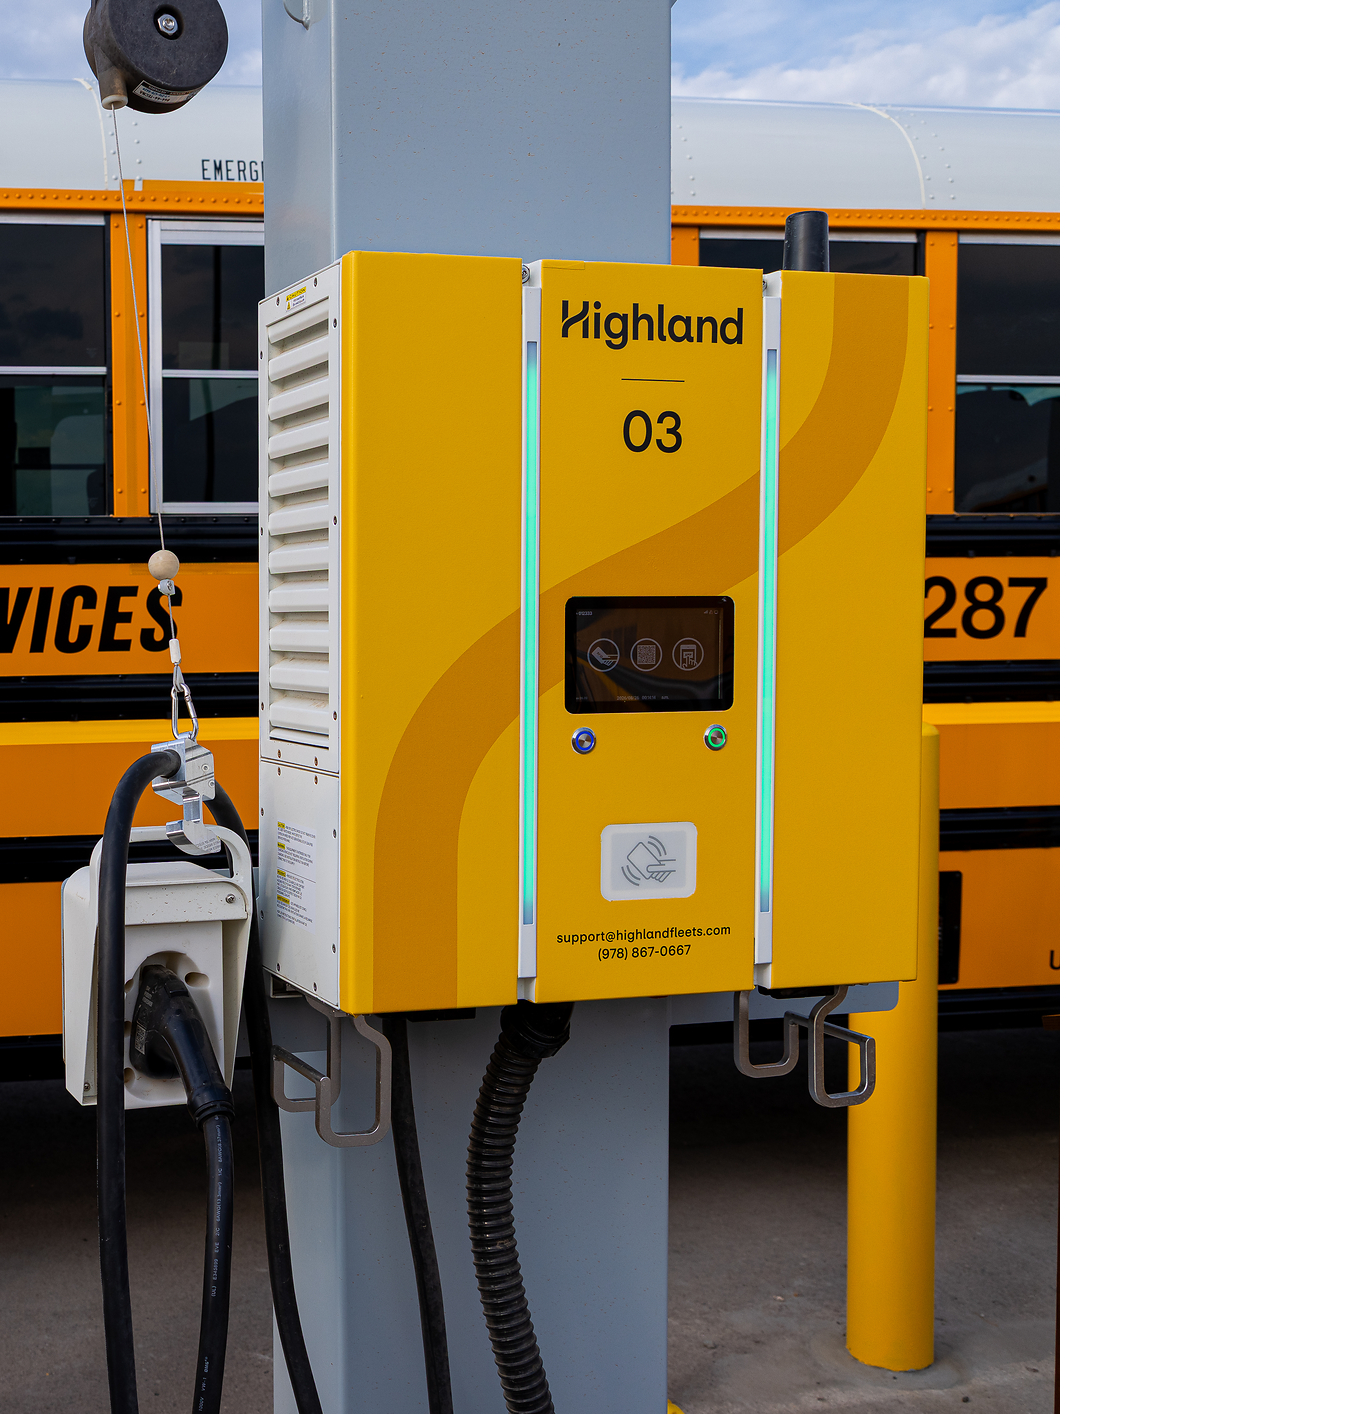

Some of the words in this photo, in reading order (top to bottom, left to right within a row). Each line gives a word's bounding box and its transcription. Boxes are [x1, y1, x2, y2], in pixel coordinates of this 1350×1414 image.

[201, 159, 264, 181] EMERG
[561, 300, 743, 350] Highland
[622, 410, 682, 454] 03
[924, 575, 1048, 640] 287
[556, 925, 731, 946] support@highlandfleets.com
[598, 947, 628, 962] (978)
[631, 944, 691, 958] 867-0667
